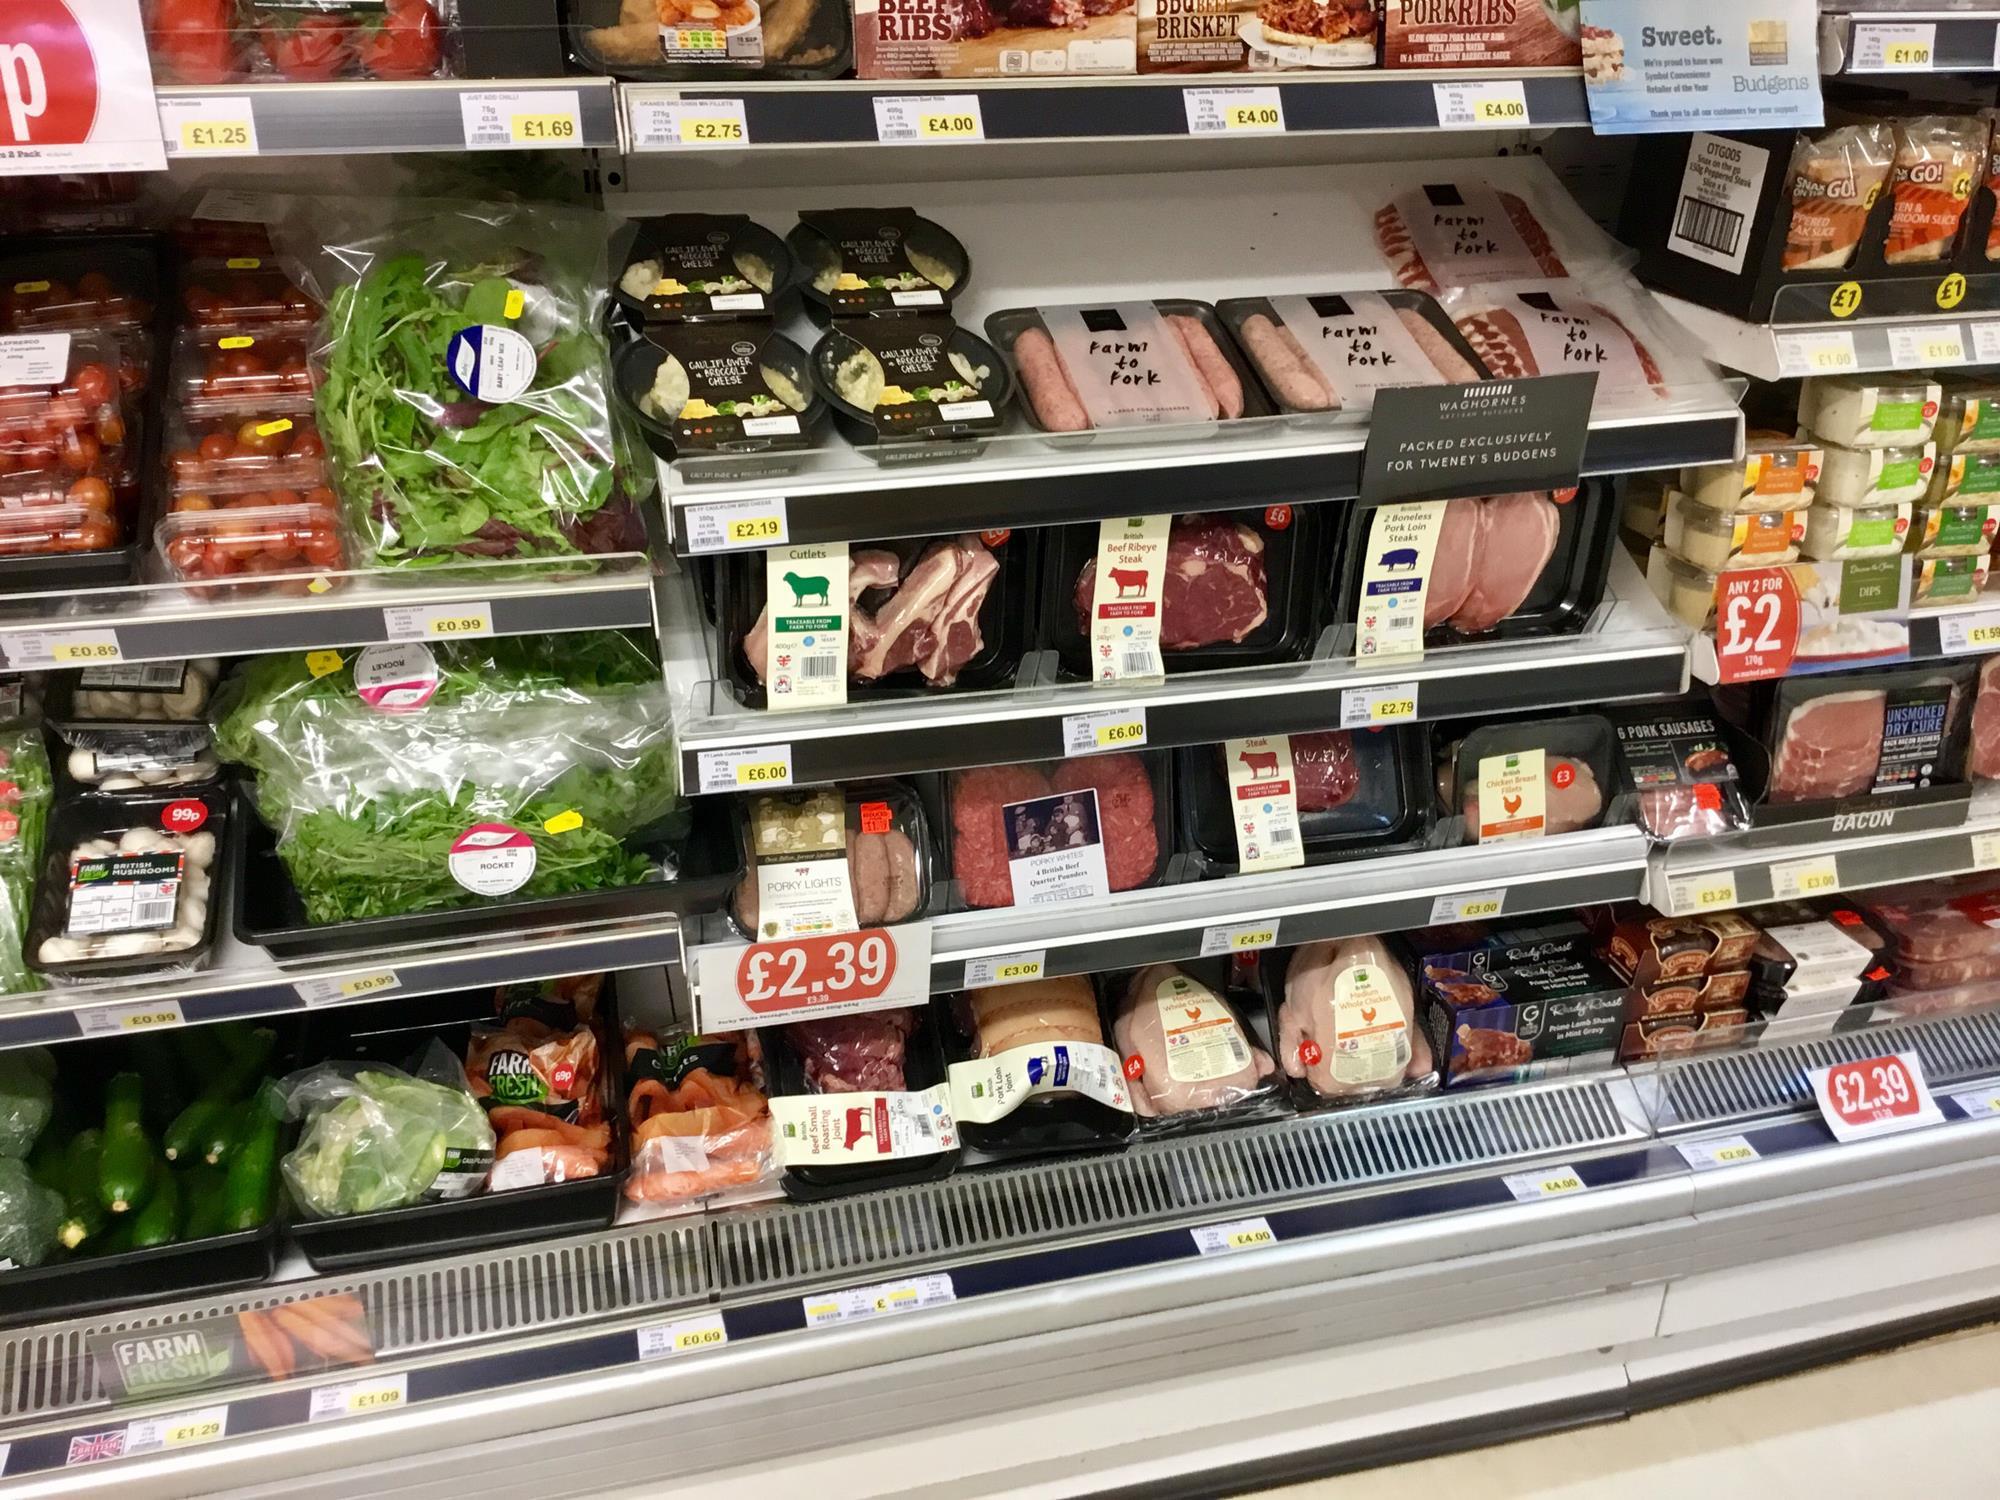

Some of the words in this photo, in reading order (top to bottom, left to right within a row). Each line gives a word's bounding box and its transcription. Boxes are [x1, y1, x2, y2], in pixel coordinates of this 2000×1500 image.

[878, 15, 953, 41] RIBS
[1156, 14, 1240, 39] BRISKET
[1449, 33, 1465, 42] PORK
[1641, 24, 1722, 48] Sweet.
[1643, 57, 1662, 68] We're
[1663, 57, 1683, 68] proud
[1684, 57, 1691, 66] to
[1692, 57, 1709, 66] have
[1709, 57, 1723, 66] won
[1894, 49, 1929, 64] £1.00
[1645, 71, 1669, 82] Symbol
[1670, 70, 1711, 80] Convenience
[1646, 84, 1673, 94] Retailer
[1673, 83, 1681, 93] of
[1682, 83, 1693, 92] the
[1694, 83, 1709, 92] Year
[1732, 74, 1810, 95] Budgens
[1237, 109, 1279, 125] £4.00
[1485, 103, 1524, 117] £4.00
[1650, 108, 1669, 118] Thank
[1670, 108, 1683, 119] you
[1684, 108, 1691, 117] to
[1692, 107, 1700, 117] all
[1701, 108, 1712, 117] our
[1713, 106, 1747, 117] customers
[1748, 106, 1757, 116] for
[1758, 107, 1772, 117] your
[1774, 105, 1799, 116] support
[524, 119, 574, 138] £1.69
[695, 122, 743, 139] £2.75
[928, 116, 974, 132] £4.00
[192, 126, 248, 145] £1.25
[1707, 142, 1742, 162] OTG005
[1704, 167, 1734, 183] Peppered
[1909, 163, 1944, 183] GO!
[1703, 177, 1717, 190] Slice
[1432, 213, 1486, 227] Farm
[1930, 215, 1959, 226] SLICE
[1456, 228, 1479, 241] to
[1832, 288, 1858, 308] £1
[1940, 279, 1963, 301] £1
[1540, 311, 1592, 326] Farm
[1321, 325, 1378, 340] Farm
[1566, 326, 1588, 343] to
[880, 346, 942, 360] CAULIFLOWER
[1089, 339, 1149, 356] Farm
[1349, 338, 1372, 354] to
[1563, 343, 1609, 363] Fork
[1928, 344, 1961, 359] £1.00
[688, 356, 753, 371] CAULIFLOWER
[1114, 354, 1140, 371] to
[1346, 351, 1397, 368] Fork
[1818, 353, 1852, 368] £1.00
[704, 366, 748, 379] BROCCOLI
[900, 362, 934, 374] CHEESE
[708, 376, 744, 387] CHEESE
[1109, 368, 1162, 387] Fork
[1438, 395, 1527, 413] WAGHORNES
[1399, 436, 1454, 454] PACKED
[1459, 431, 1552, 450] EXCLUSIVELY
[1386, 459, 1415, 473] FOR
[1419, 454, 1489, 470] TWENEY'S
[1492, 448, 1558, 464] BUDGENS
[1269, 507, 1287, 524] £6
[1384, 514, 1391, 523] 2
[1391, 511, 1433, 522] Boneless
[736, 520, 778, 538] £2.19
[1384, 522, 1406, 534] Pork
[1407, 521, 1427, 532] Loin
[1123, 531, 1144, 541] British
[1388, 532, 1419, 543] Steaks
[789, 549, 827, 560] Cutlets
[1107, 542, 1127, 554] Beef
[1128, 542, 1157, 554] Ribeye
[1118, 553, 1143, 564] Steak
[1727, 578, 1750, 596] ANY
[1752, 578, 1760, 594] 2
[1761, 576, 1783, 593] FOR
[1858, 584, 1882, 599] DIPS
[436, 618, 482, 633] £0.99
[785, 617, 815, 626] TRACEABLE
[815, 617, 832, 625] FROM
[788, 623, 804, 631] FARM
[1722, 592, 1782, 656] £2
[70, 645, 119, 657] £0.89
[1381, 700, 1414, 716] £2.79
[1886, 704, 1946, 723] UNSMOKED
[1108, 723, 1144, 741] £6.00
[1617, 727, 1626, 740] 6
[1627, 724, 1659, 738] PORK
[1659, 719, 1716, 737] SAUSAGES
[1885, 721, 1909, 737] DRY
[1911, 718, 1942, 734] CURE
[1245, 738, 1268, 749] Steak
[748, 765, 787, 781] £6.00
[1502, 769, 1520, 778] British
[1556, 770, 1570, 783] £3
[1486, 777, 1514, 789] Chicken
[1515, 774, 1537, 783] Breast
[1501, 786, 1522, 795] Fillets
[171, 807, 201, 823] 99p
[1831, 810, 1896, 833] BACON
[80, 863, 104, 873] FARM
[111, 866, 176, 877] MUSHROOMS
[112, 861, 152, 870] BRITISH
[480, 861, 515, 871] ROCKET
[1041, 864, 1065, 876] British
[1065, 862, 1080, 870] Beef
[767, 880, 802, 893] PORKY
[804, 876, 843, 889] LIGHTS
[1030, 875, 1056, 888] Quarter
[1057, 870, 1088, 882] Pounders
[1807, 875, 1835, 889] £3.00
[1702, 888, 1732, 903] £3.29
[1464, 903, 1497, 915] £3.00
[1239, 933, 1272, 946] £4.39
[744, 936, 888, 1003] £2.39
[1003, 964, 1038, 977] £3.00
[353, 975, 394, 991] £0.99
[1163, 1001, 1188, 1012] Whole
[1339, 1001, 1363, 1011] Whole
[1365, 995, 1393, 1006] Chicken
[1549, 1000, 1587, 1016] Ready
[1585, 996, 1624, 1011] Roast
[131, 1012, 177, 1026] £0.99
[1522, 1005, 1540, 1022] G
[1549, 1020, 1571, 1033] Prime
[1571, 1017, 1592, 1029] Lamb
[1592, 1015, 1616, 1026] Shank
[1556, 1031, 1565, 1040] in
[1565, 1028, 1583, 1038] Mint
[1583, 1026, 1605, 1039] Gravy
[1304, 1044, 1318, 1062] £4
[1127, 1059, 1141, 1076] £4
[554, 1070, 573, 1083] 69p
[995, 1066, 1003, 1086] Loin
[1005, 1072, 1016, 1092] Joint
[489, 1074, 542, 1099] FRESH
[1834, 1064, 1911, 1115] £2.39
[995, 1086, 1006, 1105] Pork
[808, 1106, 818, 1132] Small
[822, 1109, 832, 1150] Roasting
[832, 1118, 843, 1141] Joint
[811, 1132, 820, 1155] Beef
[1720, 1148, 1752, 1160] £2.00
[1545, 1179, 1577, 1191] £4.00
[1236, 1231, 1271, 1245] £4.00
[877, 1298, 886, 1309] £
[683, 1331, 721, 1347] £0.69
[118, 1333, 201, 1366] FARM
[124, 1357, 207, 1386] FRESH
[357, 1391, 400, 1407] £1.09
[176, 1422, 220, 1440] £1.29
[78, 1440, 120, 1455] BRITISH
